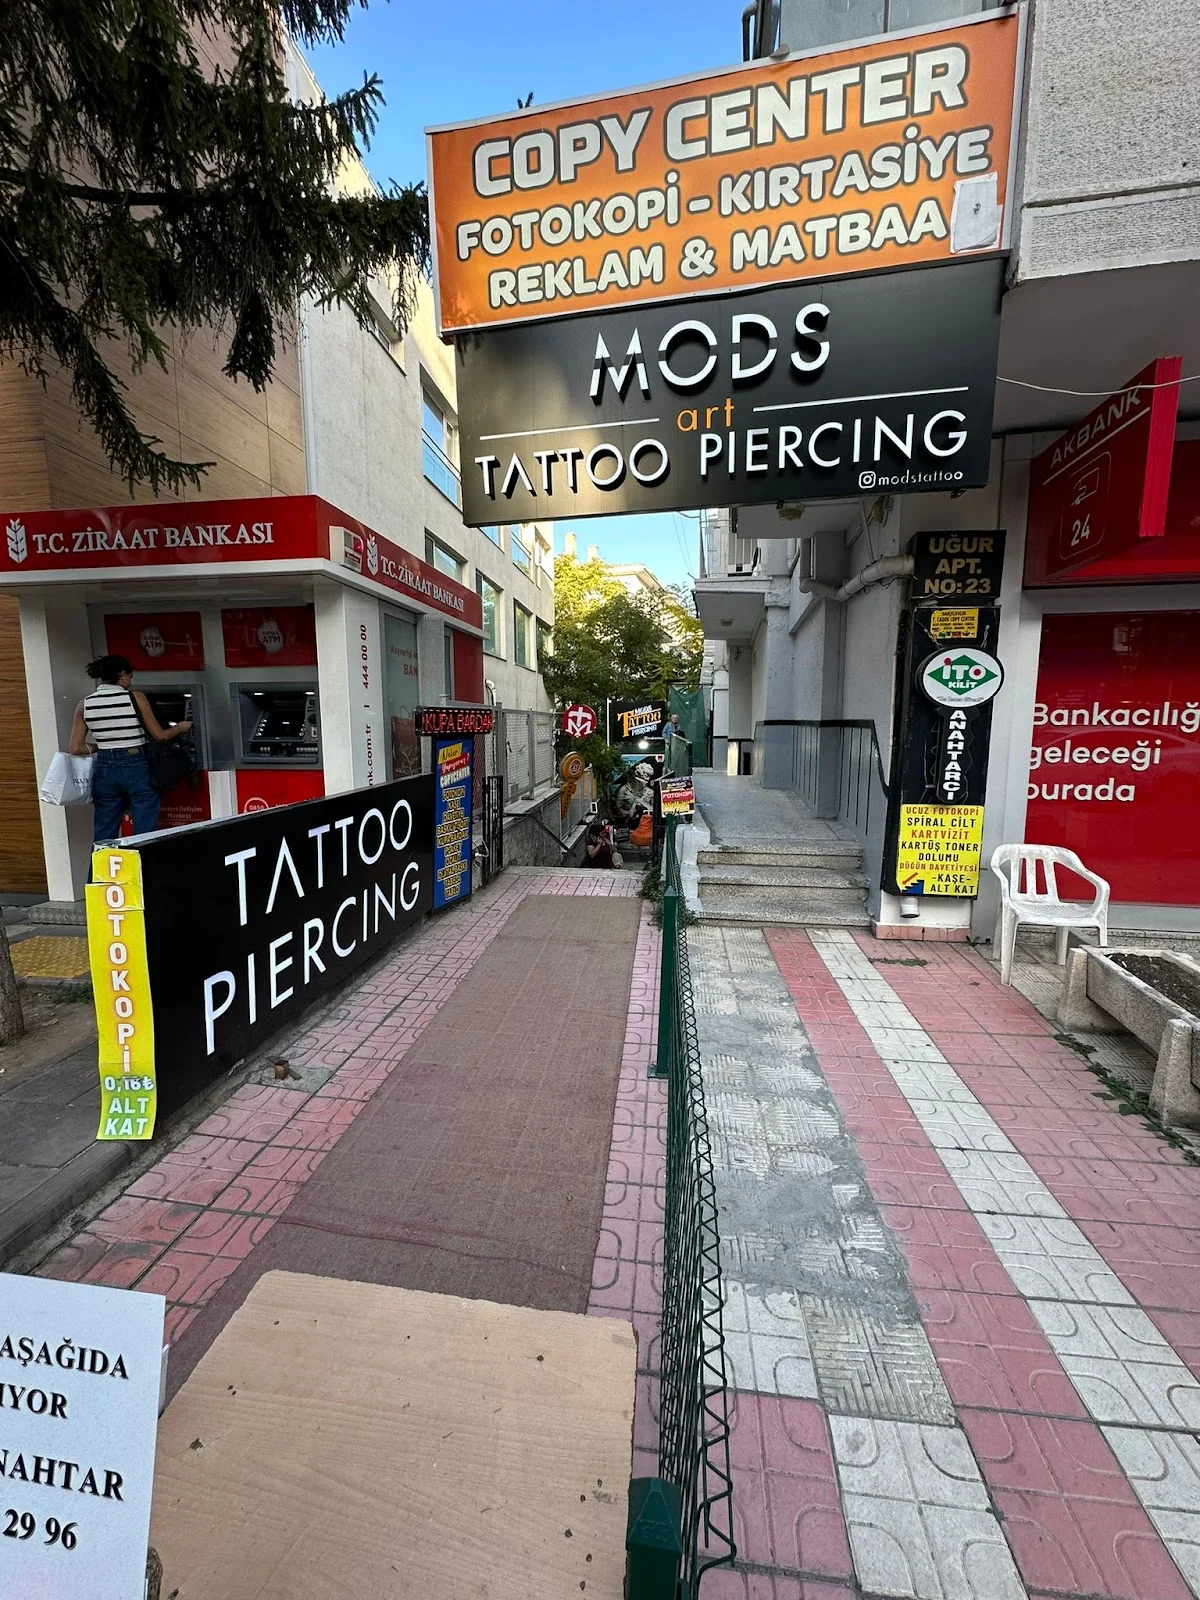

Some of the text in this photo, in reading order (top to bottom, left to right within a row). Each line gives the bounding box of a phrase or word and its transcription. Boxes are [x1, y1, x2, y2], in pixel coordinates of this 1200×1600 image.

[474, 44, 969, 197] COPY CENTER
[457, 172, 681, 260] FOTOKOPİ
[719, 125, 993, 216] KIRTASİYE
[489, 199, 950, 309] REKLAM & MATBAA
[589, 303, 832, 399] MODS
[676, 398, 736, 432] art
[1051, 382, 1143, 469] AKBANK
[475, 409, 968, 500] TATTOO PIERCING
[878, 468, 964, 486] modstattoo
[33, 522, 275, 554] T.C. ZİRAAT BANKASI
[929, 533, 994, 554] UĞUR
[1071, 514, 1091, 547] 24
[935, 558, 982, 574] APT.
[380, 556, 465, 613] T.C. ZİRAAT BANKASI
[262, 635, 281, 644] ATM
[360, 624, 367, 641] 00
[361, 645, 368, 661] 00
[948, 680, 977, 688] KİLİT
[425, 714, 454, 731] KUPA
[617, 710, 661, 738] TATTOO
[942, 709, 967, 800] ANAHTARCI
[1030, 739, 1162, 771] geleceği
[906, 807, 979, 816] UCUZ FOTOKOPİ
[907, 815, 976, 828] SPİRAL CİLT
[901, 840, 979, 852] KARTÜŞ TONER
[911, 828, 970, 840] KARTVİZİT
[224, 799, 413, 926] TATTOO
[900, 861, 977, 872] DÜĞÜN DAVETİYESİ
[919, 853, 959, 862] DOLUMU
[930, 884, 975, 894] ALT KAT
[105, 856, 135, 1072] FOTOKOPİ
[203, 861, 420, 1055] PIERCING
[109, 1097, 149, 1114] ALT
[105, 1117, 148, 1136] KAT
[0, 1334, 129, 1379] AŞAĞIDA
[3, 1508, 79, 1550] 29 96
